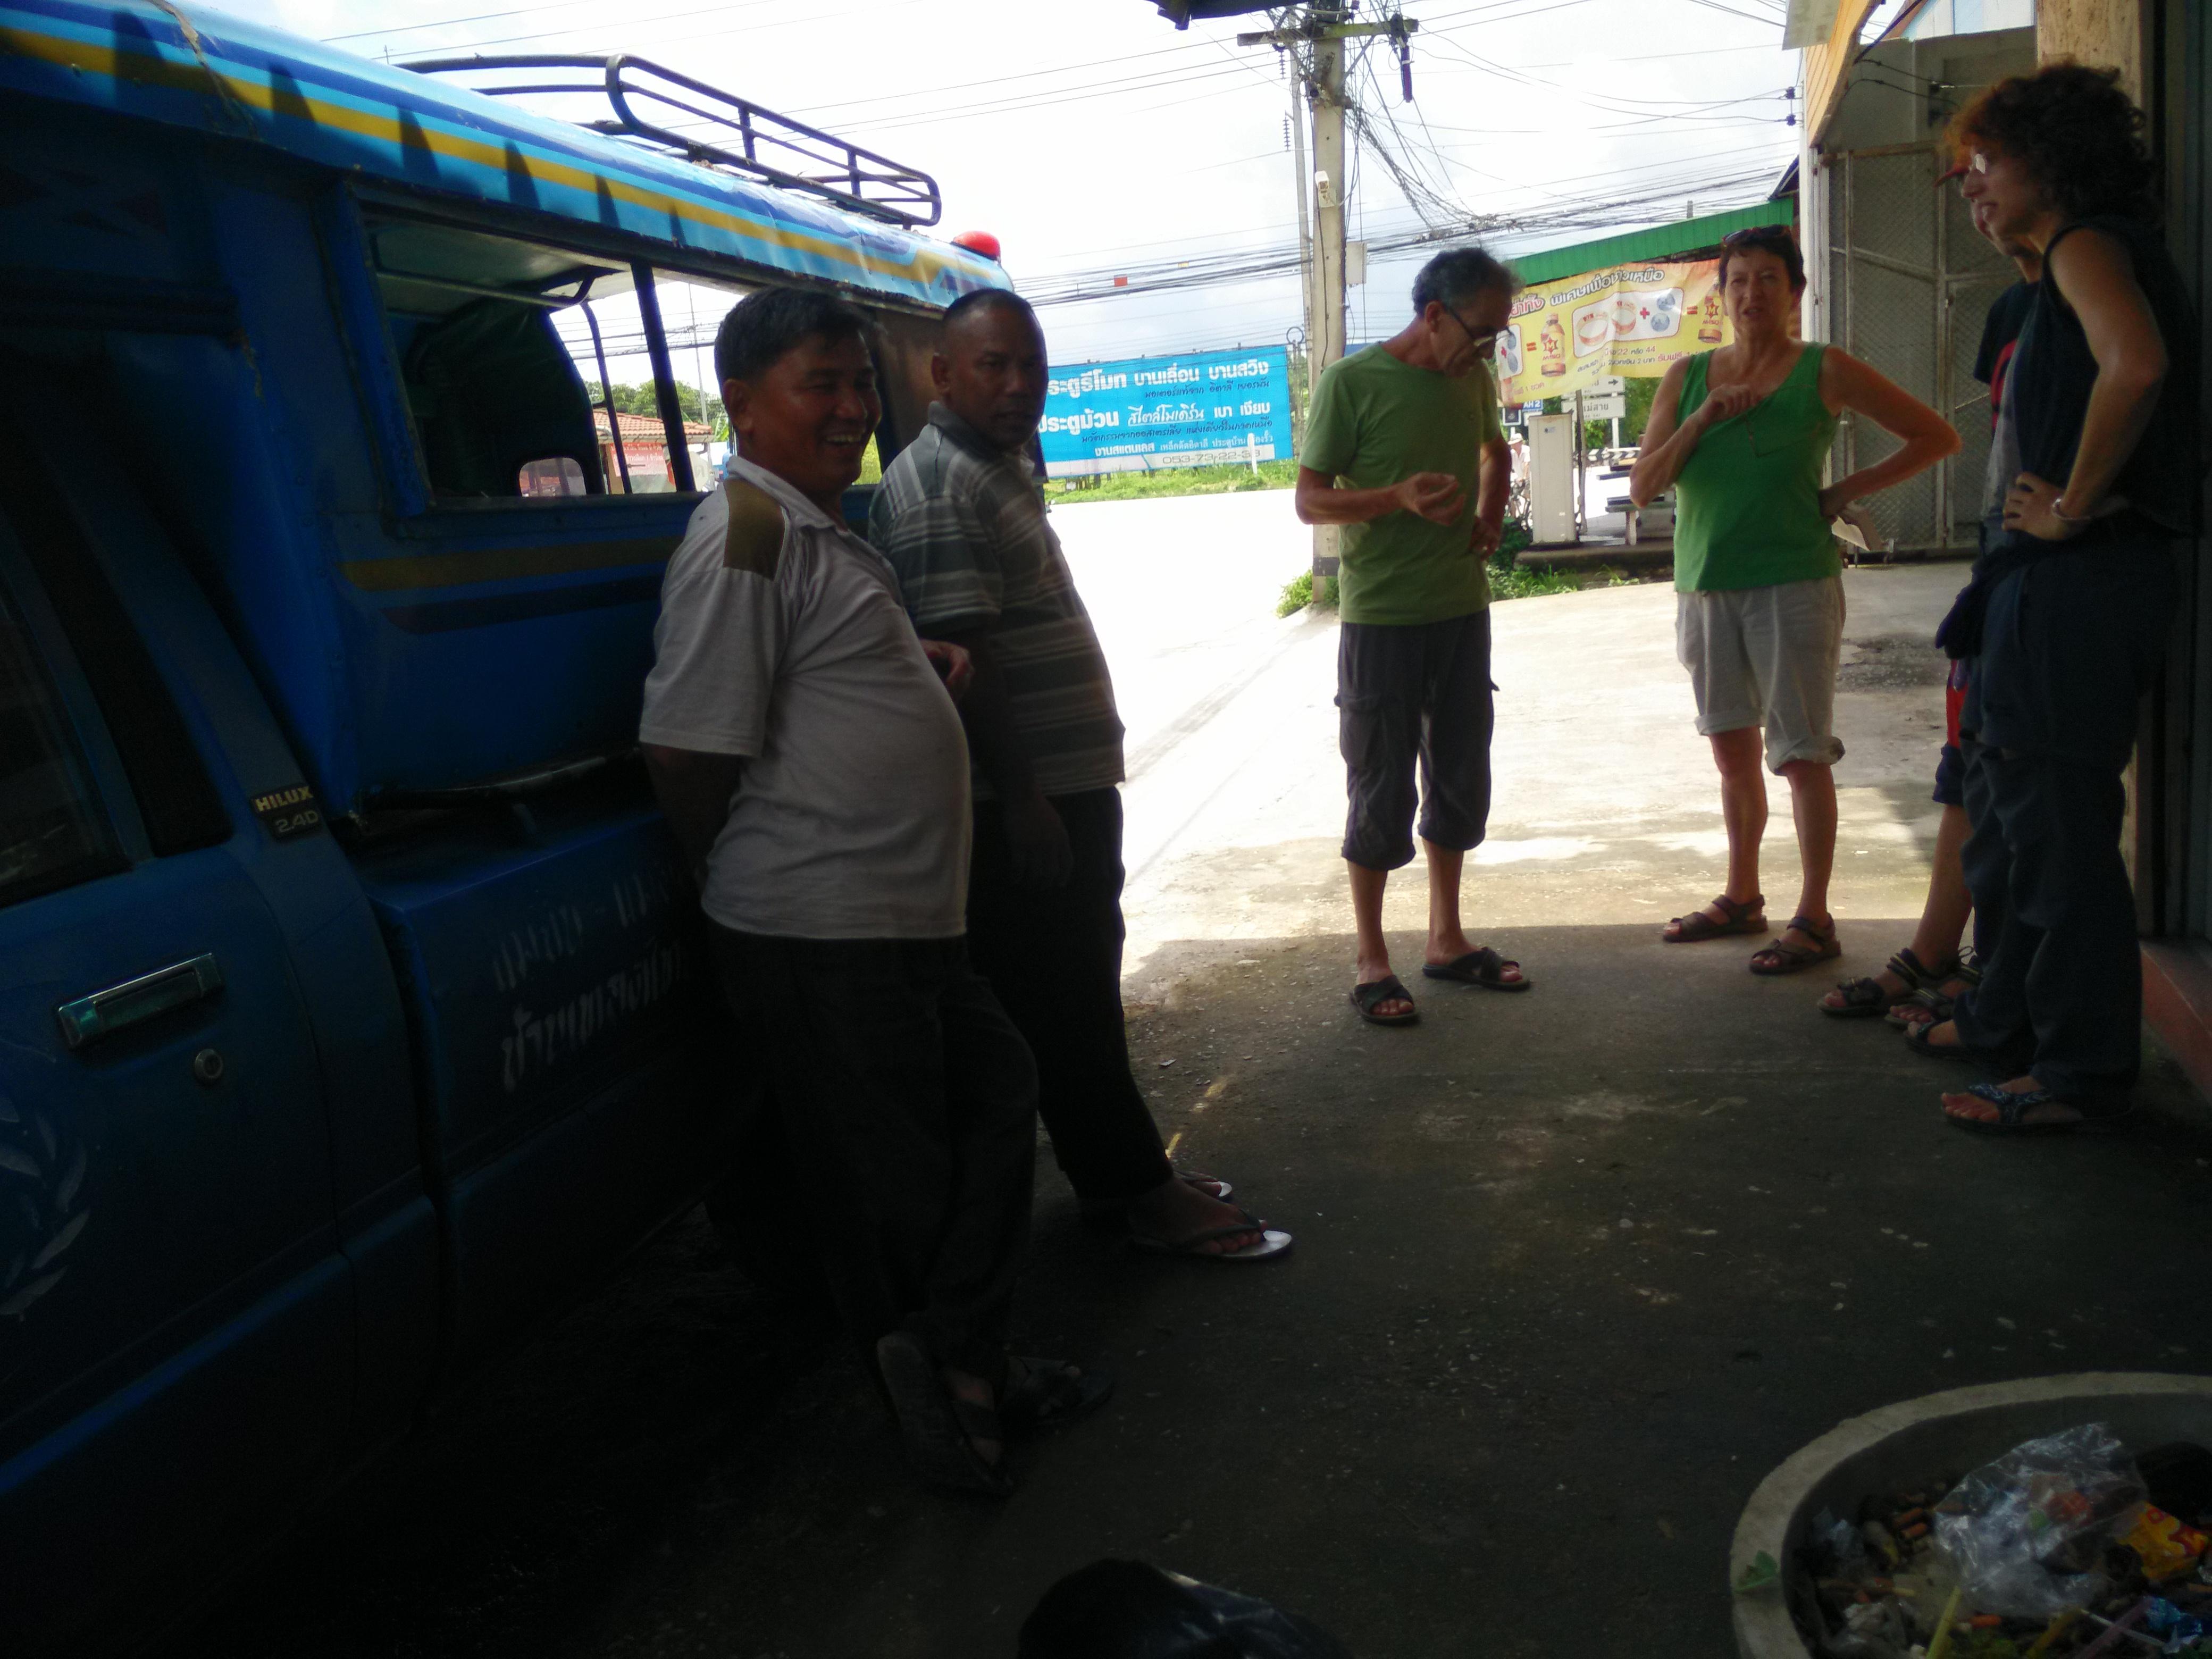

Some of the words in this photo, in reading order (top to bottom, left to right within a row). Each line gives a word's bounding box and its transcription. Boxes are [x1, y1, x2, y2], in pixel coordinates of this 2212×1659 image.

[1047, 368, 1127, 398] ระตูรีโมท
[1134, 363, 1200, 386] บานเลื่อน
[1209, 359, 1269, 380] บานสวิง
[1038, 408, 1119, 435] ประตูม้วน
[1214, 406, 1233, 418] เบา
[1240, 400, 1271, 417] เงียบ
[255, 785, 314, 812] HILUX
[274, 809, 319, 833] 2.4D
